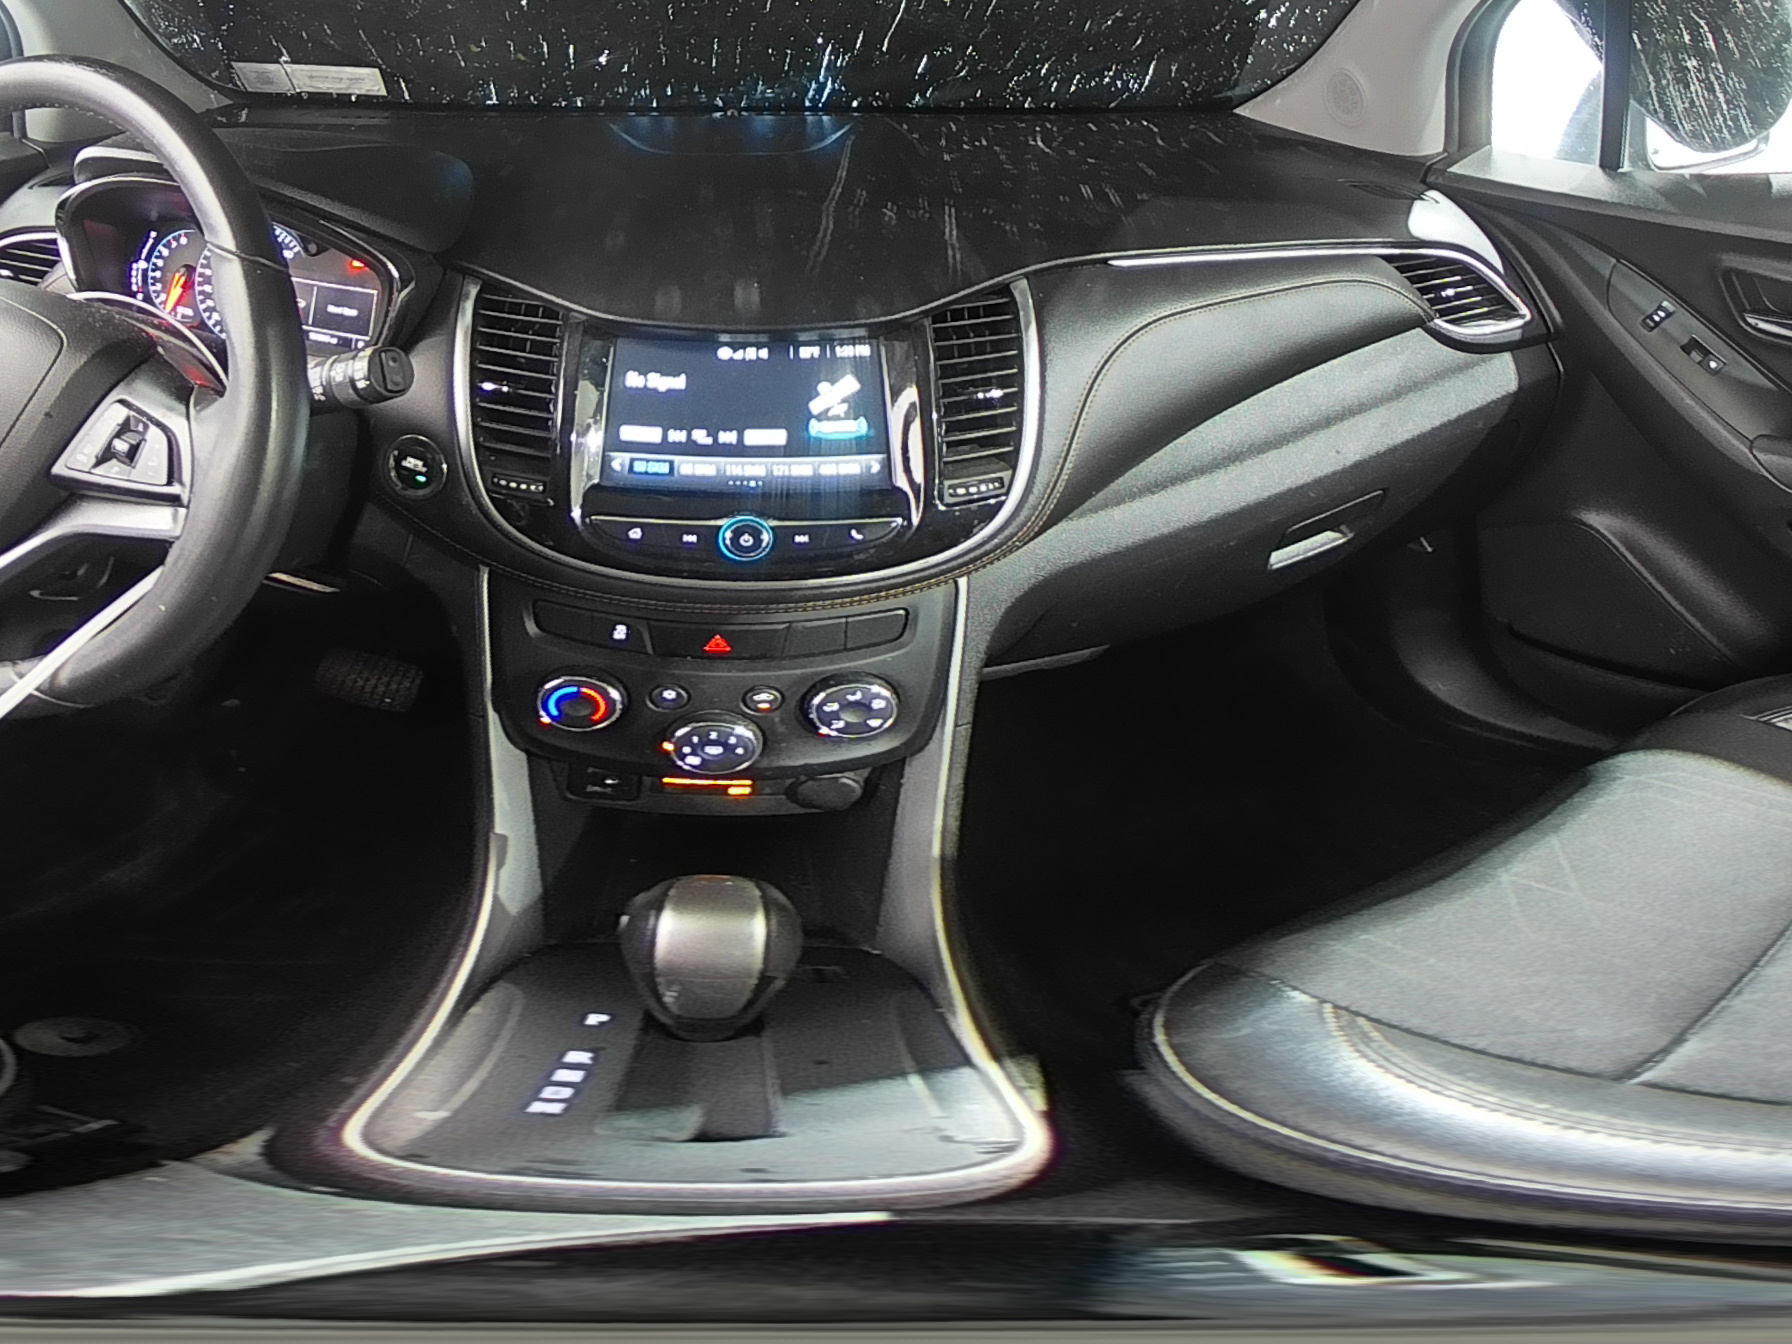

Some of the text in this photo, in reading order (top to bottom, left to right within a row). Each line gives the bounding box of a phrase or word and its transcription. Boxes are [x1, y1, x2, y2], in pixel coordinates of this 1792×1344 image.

[625, 370, 686, 392] No Signal
[583, 1013, 612, 1026] P
[561, 1050, 595, 1064] R
[538, 1086, 575, 1099] D
